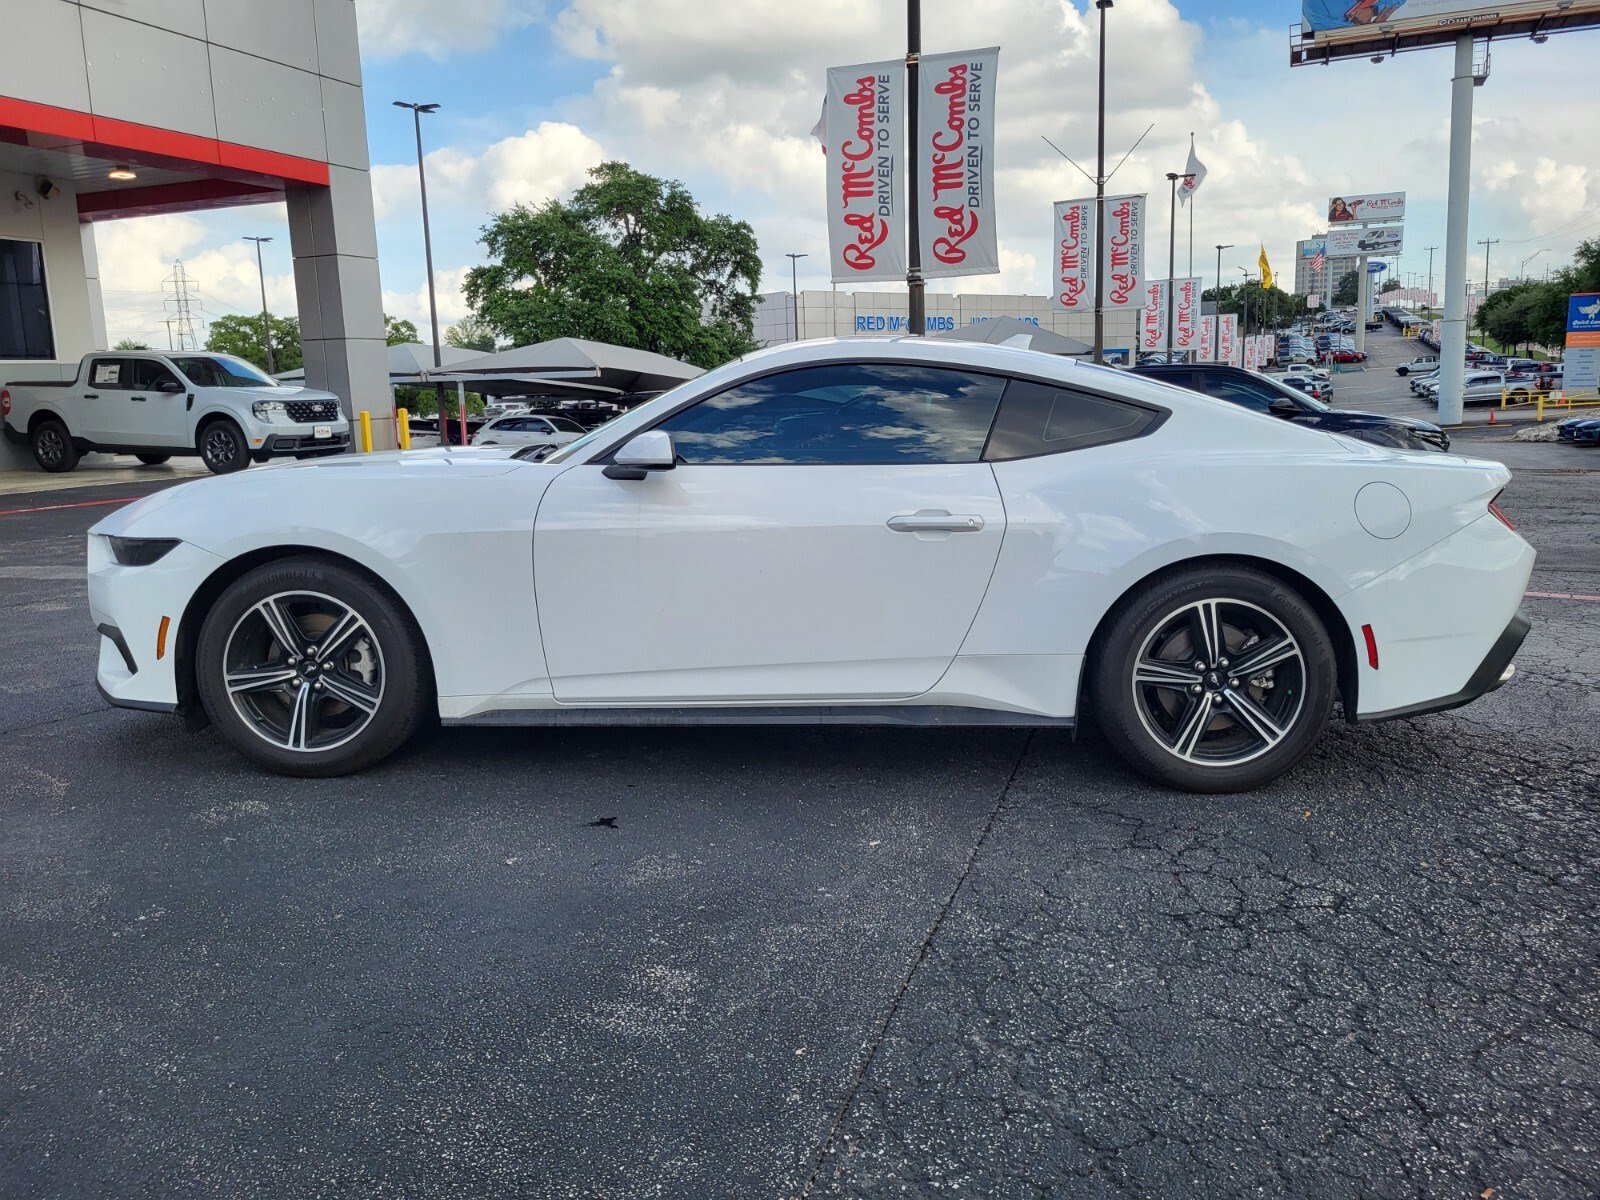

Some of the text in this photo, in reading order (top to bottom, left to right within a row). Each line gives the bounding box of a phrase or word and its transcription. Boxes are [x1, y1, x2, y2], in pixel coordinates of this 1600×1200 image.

[878, 74, 890, 217] DRIVEN TO SERVE
[932, 63, 979, 265] Red McCombs
[968, 62, 983, 208] DRIVEN TO SERVE
[841, 75, 888, 270] Red McCombs
[1081, 233, 1088, 246] TO
[1131, 201, 1139, 227] SERVE
[1131, 229, 1138, 242] TO
[1060, 205, 1086, 307] Red McCombs
[1110, 201, 1136, 305] Red McCombs
[856, 316, 885, 331] RED
[889, 316, 955, 331] McMBS
[1145, 329, 1162, 347] Red
[1178, 327, 1194, 346] Red
